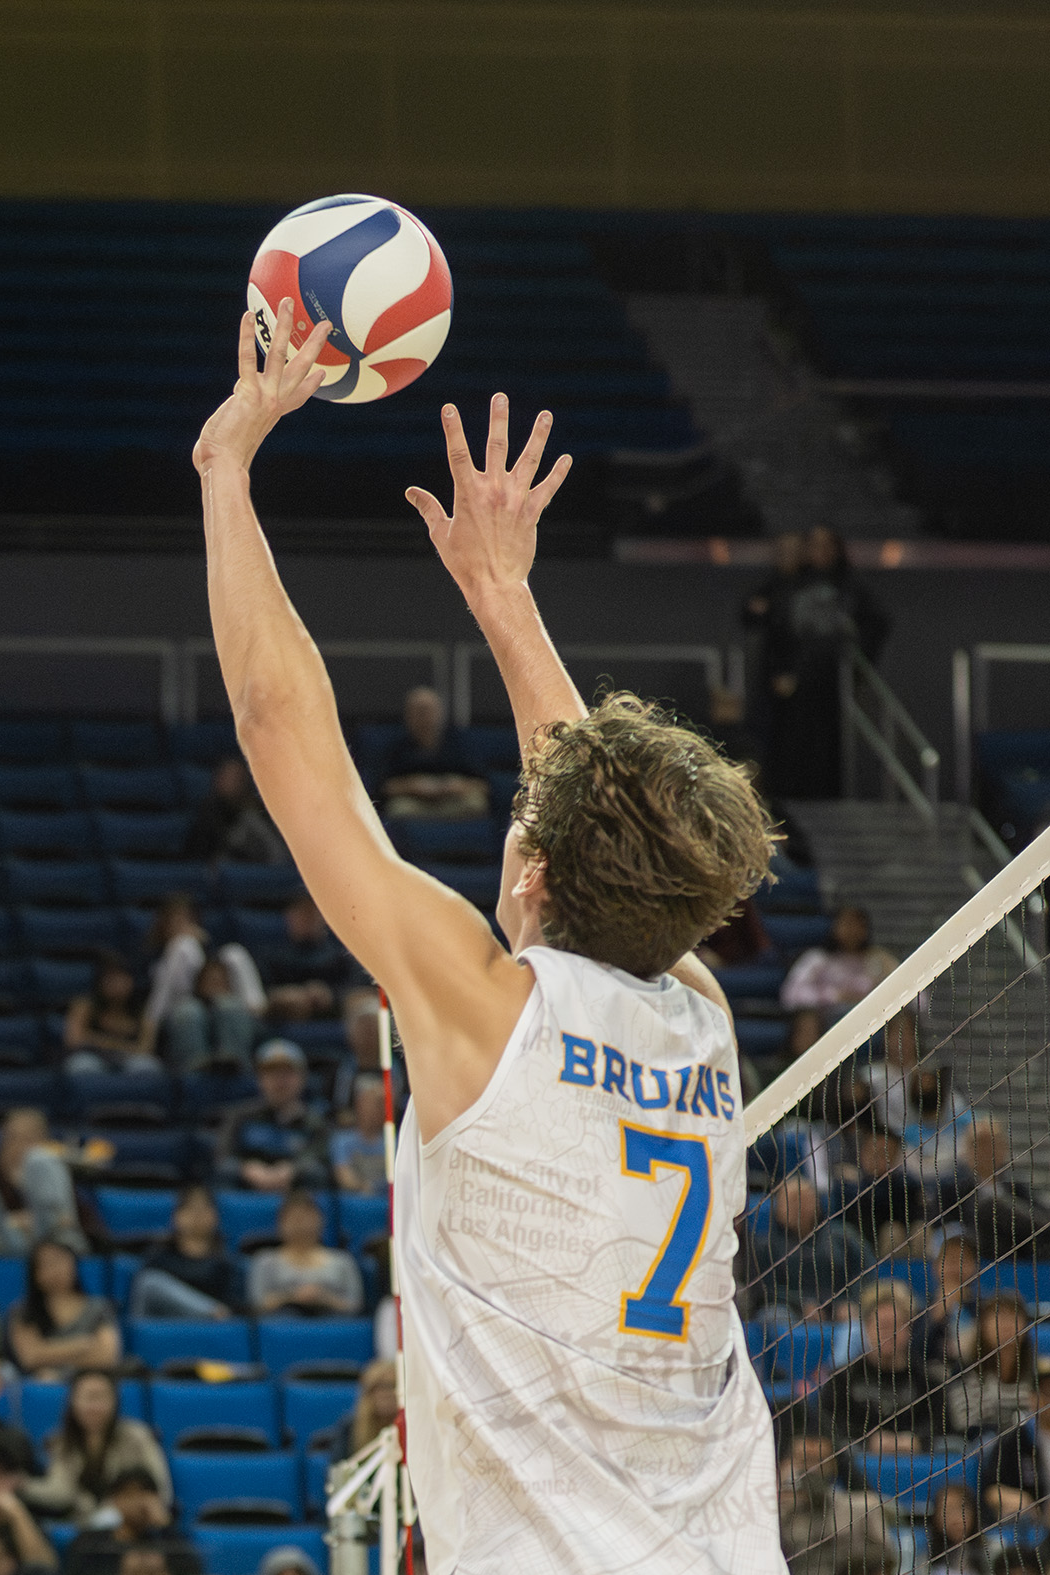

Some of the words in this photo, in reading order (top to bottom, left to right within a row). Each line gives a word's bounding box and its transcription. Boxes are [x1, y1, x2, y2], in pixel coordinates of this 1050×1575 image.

[557, 1032, 737, 1122] BRUINS
[495, 1219, 596, 1257] Angeles
[618, 1118, 714, 1343] 7
